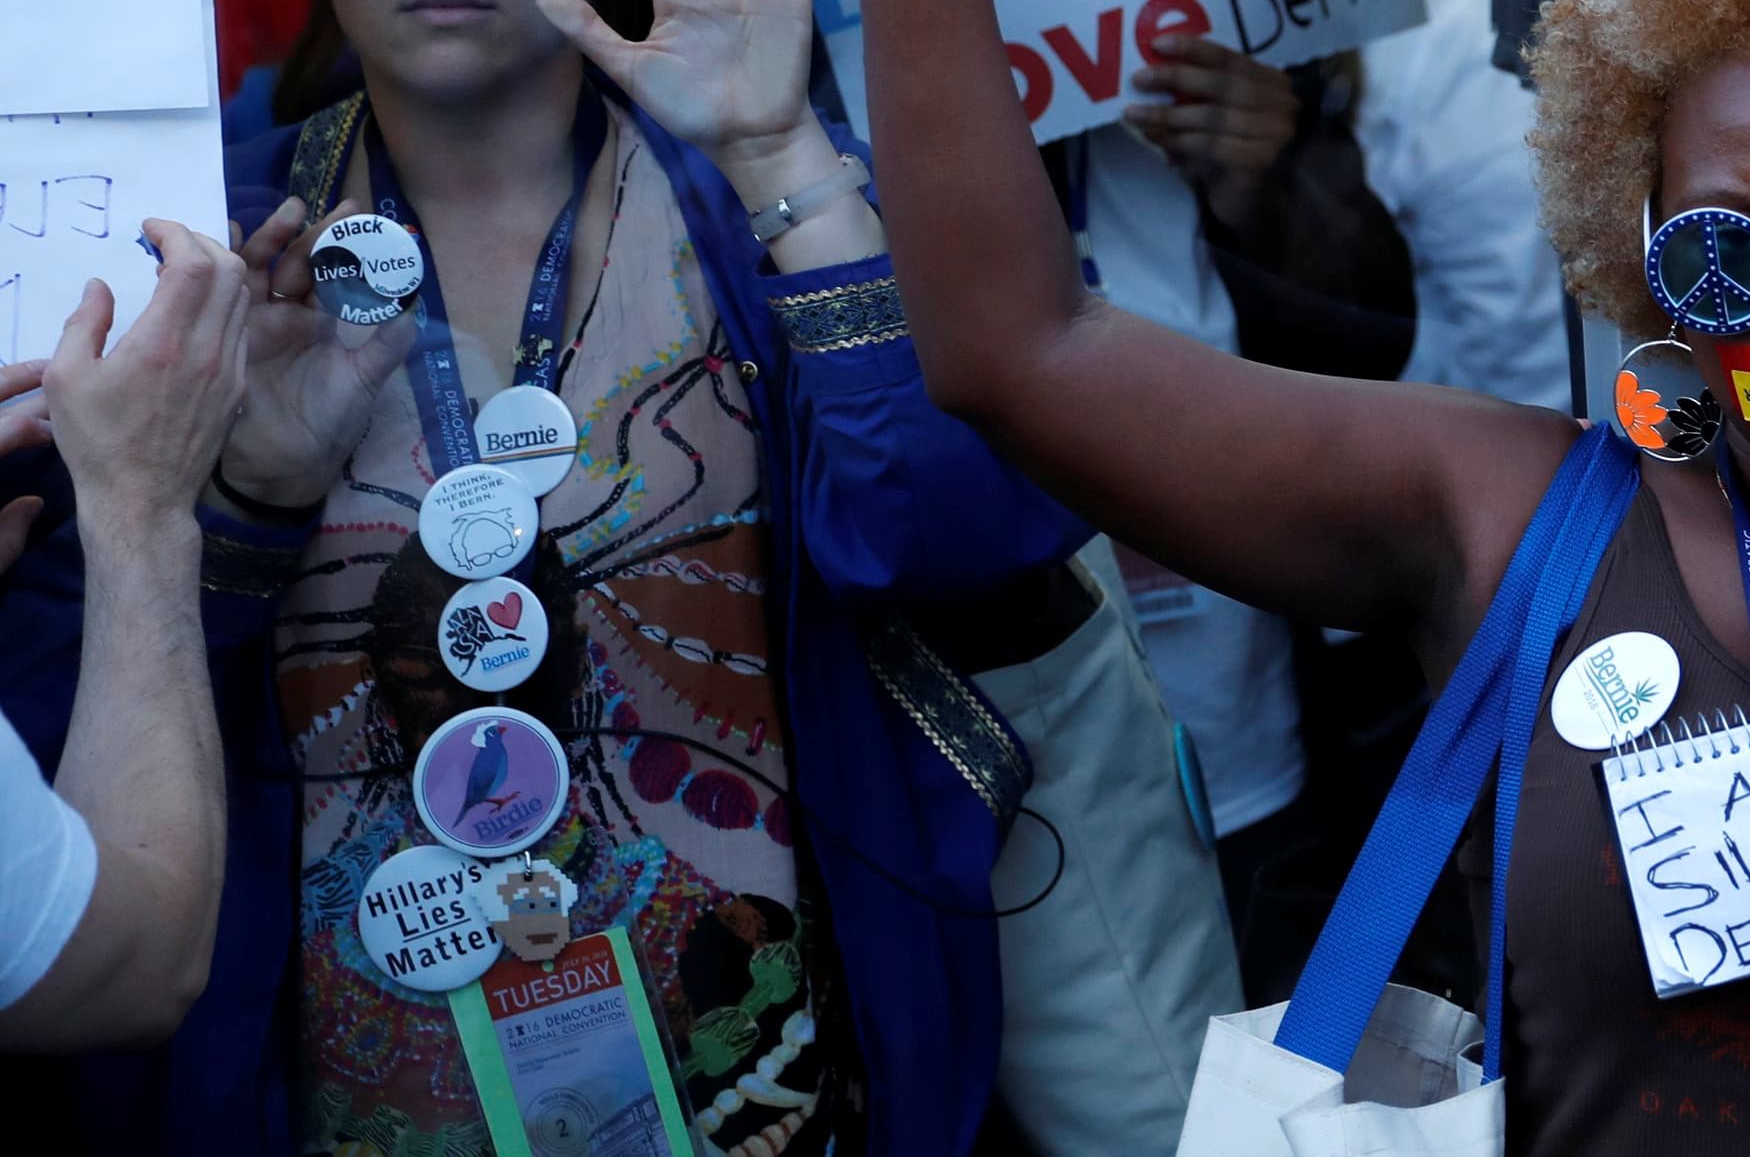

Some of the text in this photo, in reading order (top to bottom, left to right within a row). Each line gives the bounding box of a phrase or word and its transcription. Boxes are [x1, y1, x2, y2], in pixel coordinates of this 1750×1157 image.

[332, 216, 385, 242] Black
[340, 297, 404, 325] Matter
[486, 423, 559, 453] Bernie
[434, 477, 505, 506] THEREFORE
[479, 645, 530, 672] Bernie
[1590, 645, 1640, 725] Bernie
[472, 795, 544, 841] Birdie
[1618, 790, 1686, 853] I
[366, 861, 483, 918] Hillary's
[396, 899, 466, 938] Lies
[492, 962, 613, 1013] TUESDAY
[508, 1009, 626, 1051] NATIONAL CONVENTION
[545, 996, 623, 1029] DEMOCRATIC
[555, 1118, 569, 1139] 2
